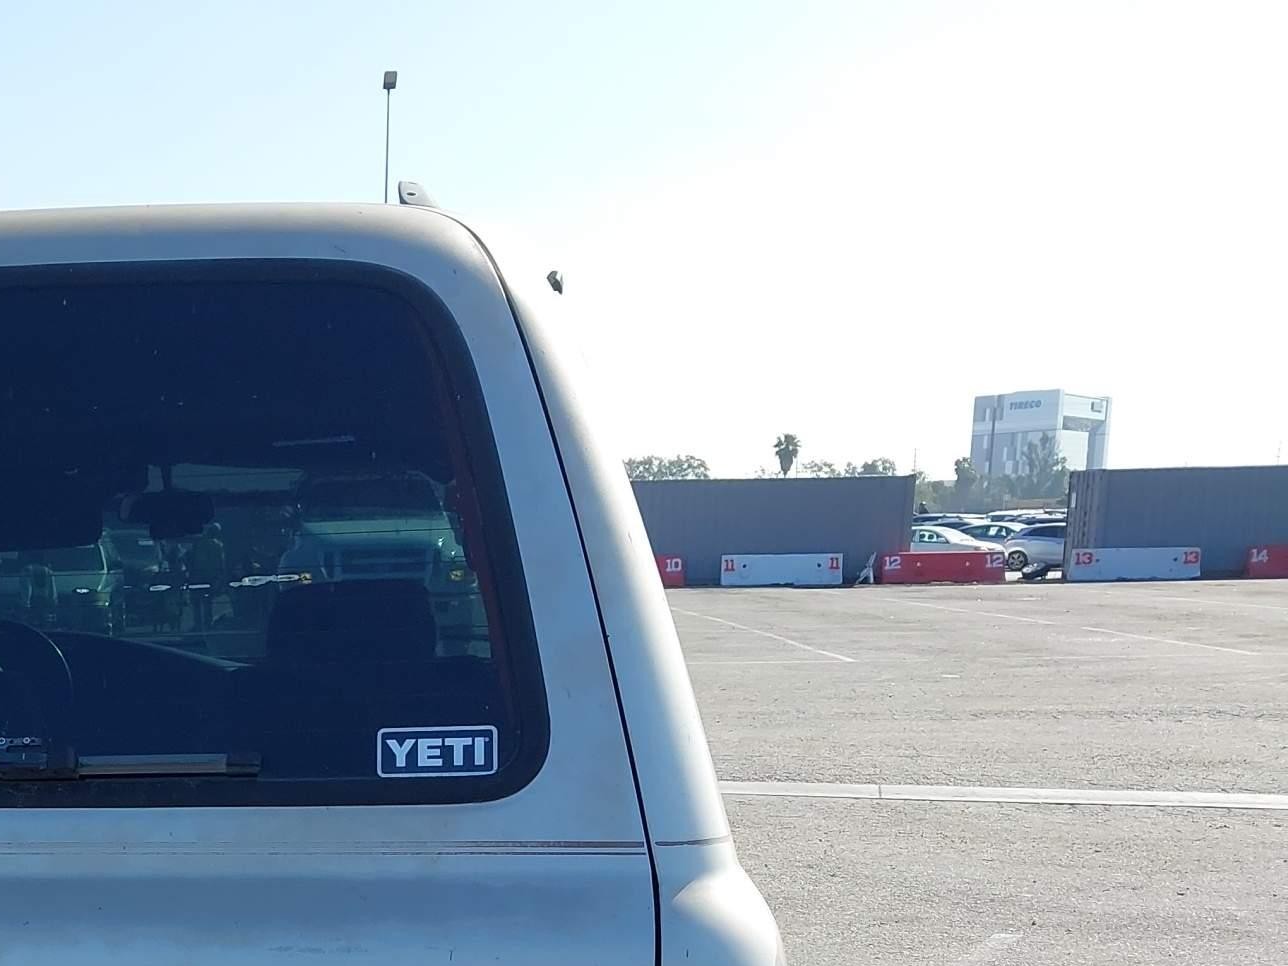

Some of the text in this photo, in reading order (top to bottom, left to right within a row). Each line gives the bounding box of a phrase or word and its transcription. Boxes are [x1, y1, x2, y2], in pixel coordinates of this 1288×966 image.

[986, 554, 1003, 568] 12
[1075, 552, 1093, 565] 13
[1183, 551, 1199, 564] 13
[1251, 549, 1268, 562] 14
[665, 558, 682, 572] 10
[724, 559, 735, 572] 11
[829, 557, 840, 570] 11
[884, 556, 901, 570] 12
[386, 737, 485, 767] YETI
